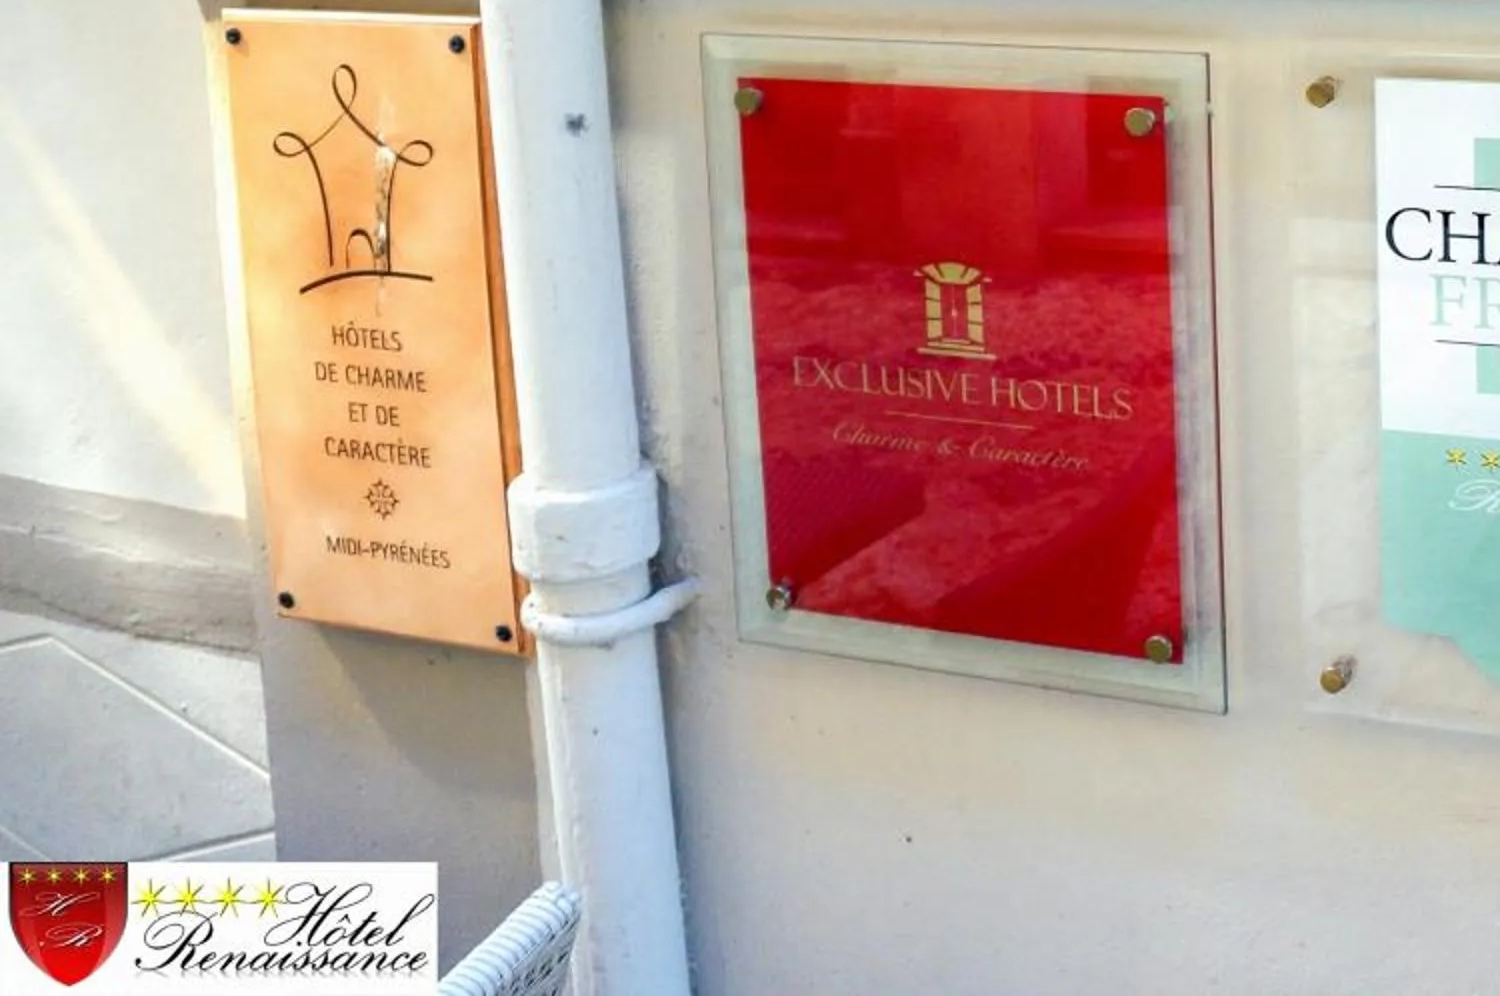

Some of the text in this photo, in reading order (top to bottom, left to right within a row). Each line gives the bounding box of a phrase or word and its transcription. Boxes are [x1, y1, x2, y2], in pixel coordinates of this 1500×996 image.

[331, 321, 404, 352] HÔTELS
[315, 361, 428, 393] DE CHARME
[793, 356, 1134, 421] EXCLUSIVE HOTELS
[347, 402, 401, 428] ET DE
[324, 437, 433, 469] CARACTÈRE
[833, 422, 1092, 470] Charme & Caractère
[325, 536, 451, 569] MIDI-PYRÉNÉES
